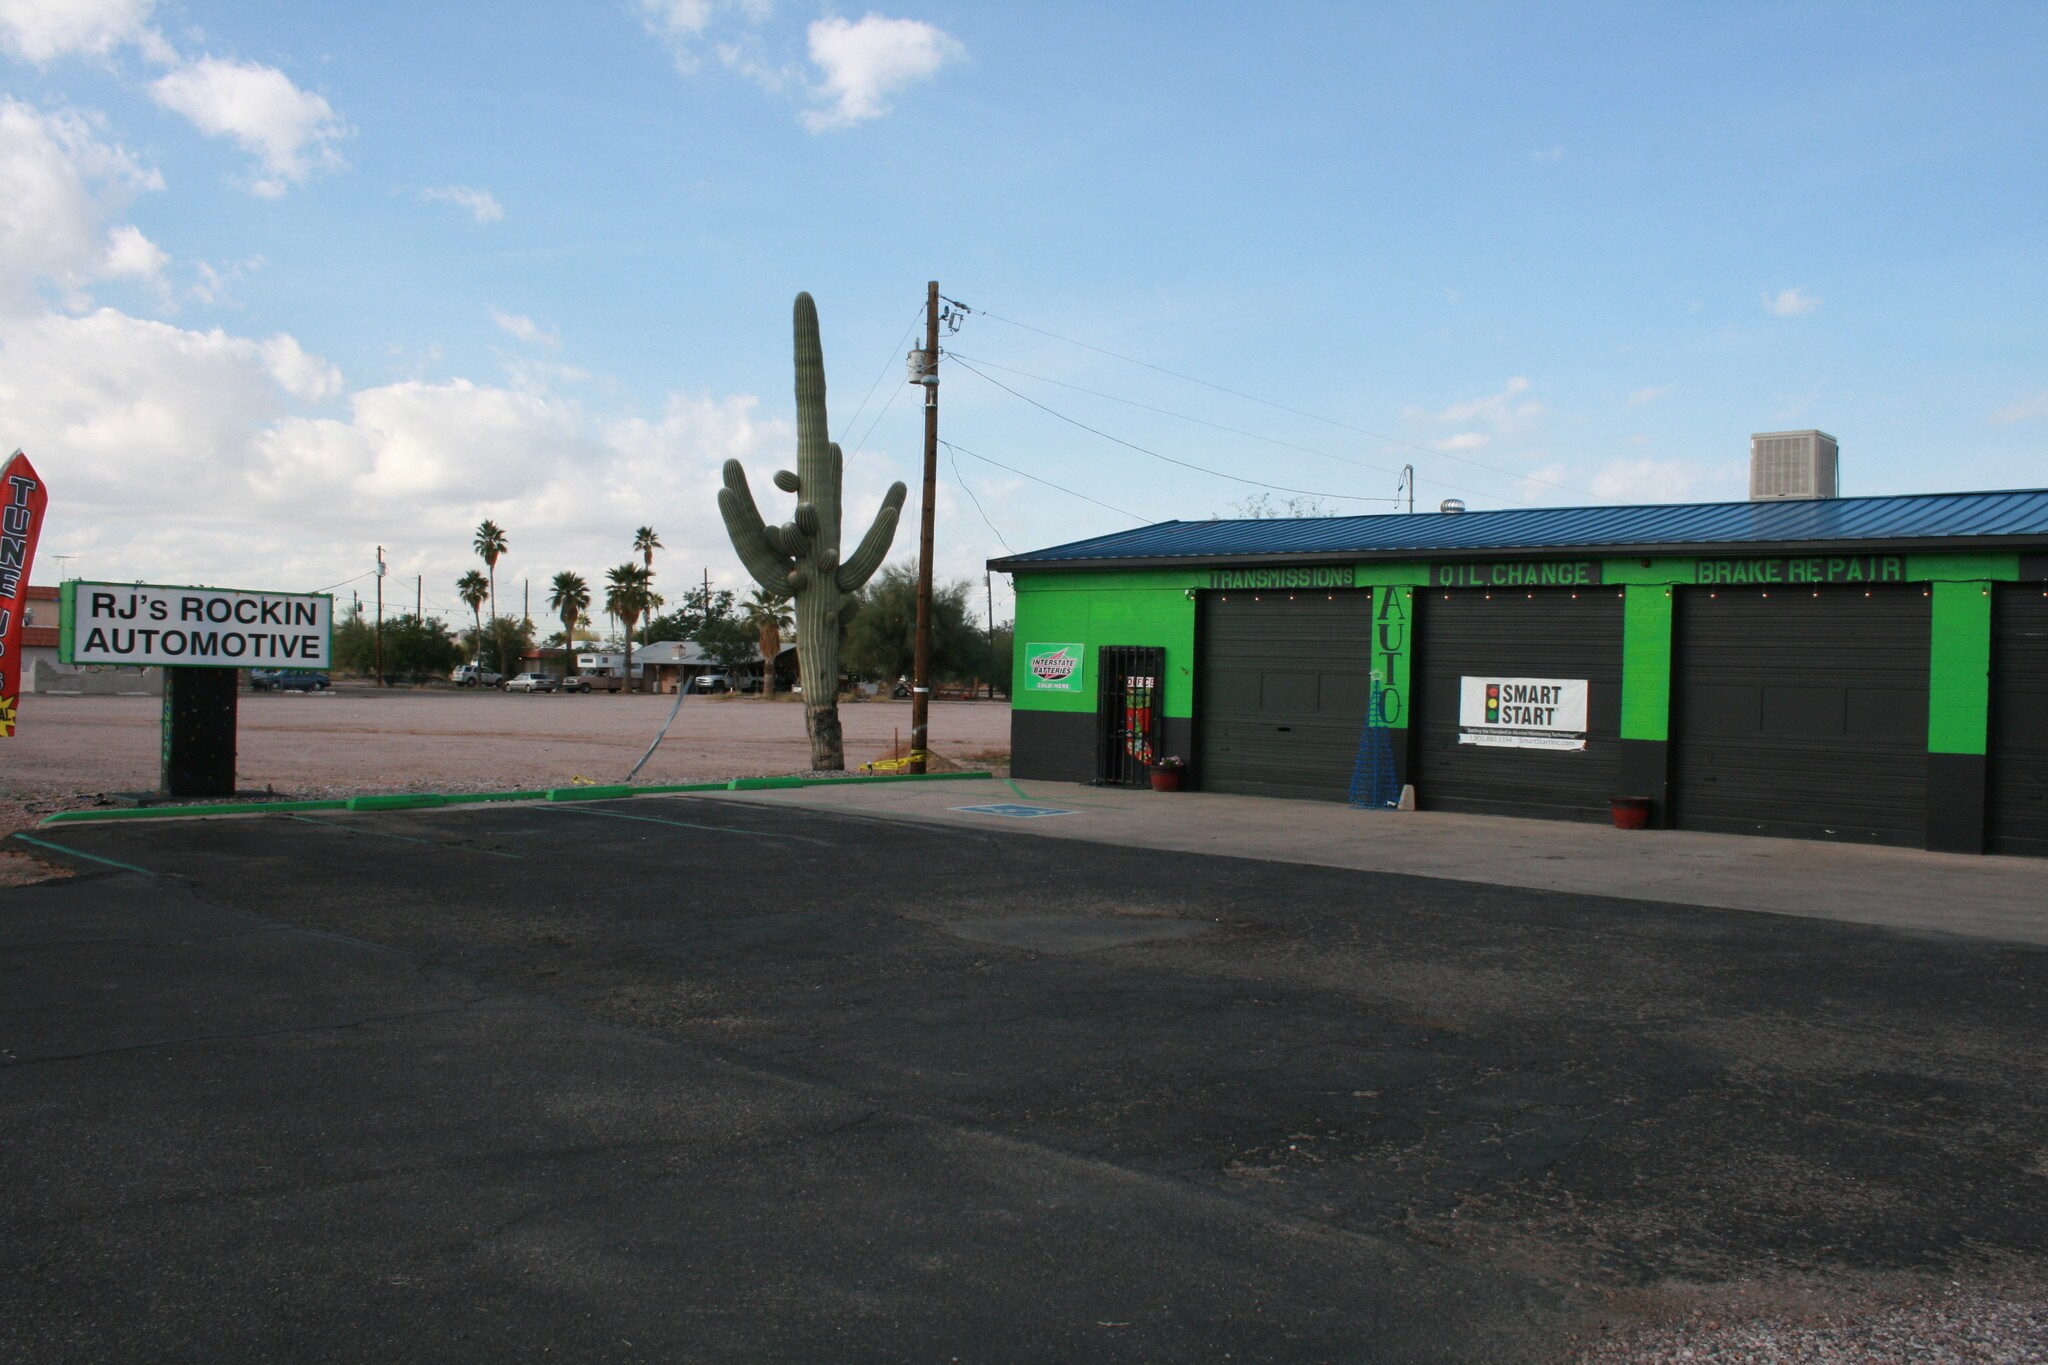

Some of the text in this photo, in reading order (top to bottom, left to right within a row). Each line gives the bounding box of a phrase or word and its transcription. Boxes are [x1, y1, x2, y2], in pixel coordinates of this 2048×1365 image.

[0, 475, 36, 599] TUNE
[1210, 566, 1353, 588] TRANSMISSIONS
[1439, 562, 1590, 585] OIL CHANGE
[1698, 557, 1901, 583] BRAKE REPAIR
[92, 592, 317, 626] RJ's ROCKIN
[83, 627, 320, 659] AUTOMOTIVE
[1377, 585, 1406, 724] AUTO
[1032, 658, 1075, 667] INTERSTATE
[1127, 678, 1154, 686] OFCE
[1502, 684, 1562, 705] SMART
[1502, 705, 1555, 726] START
